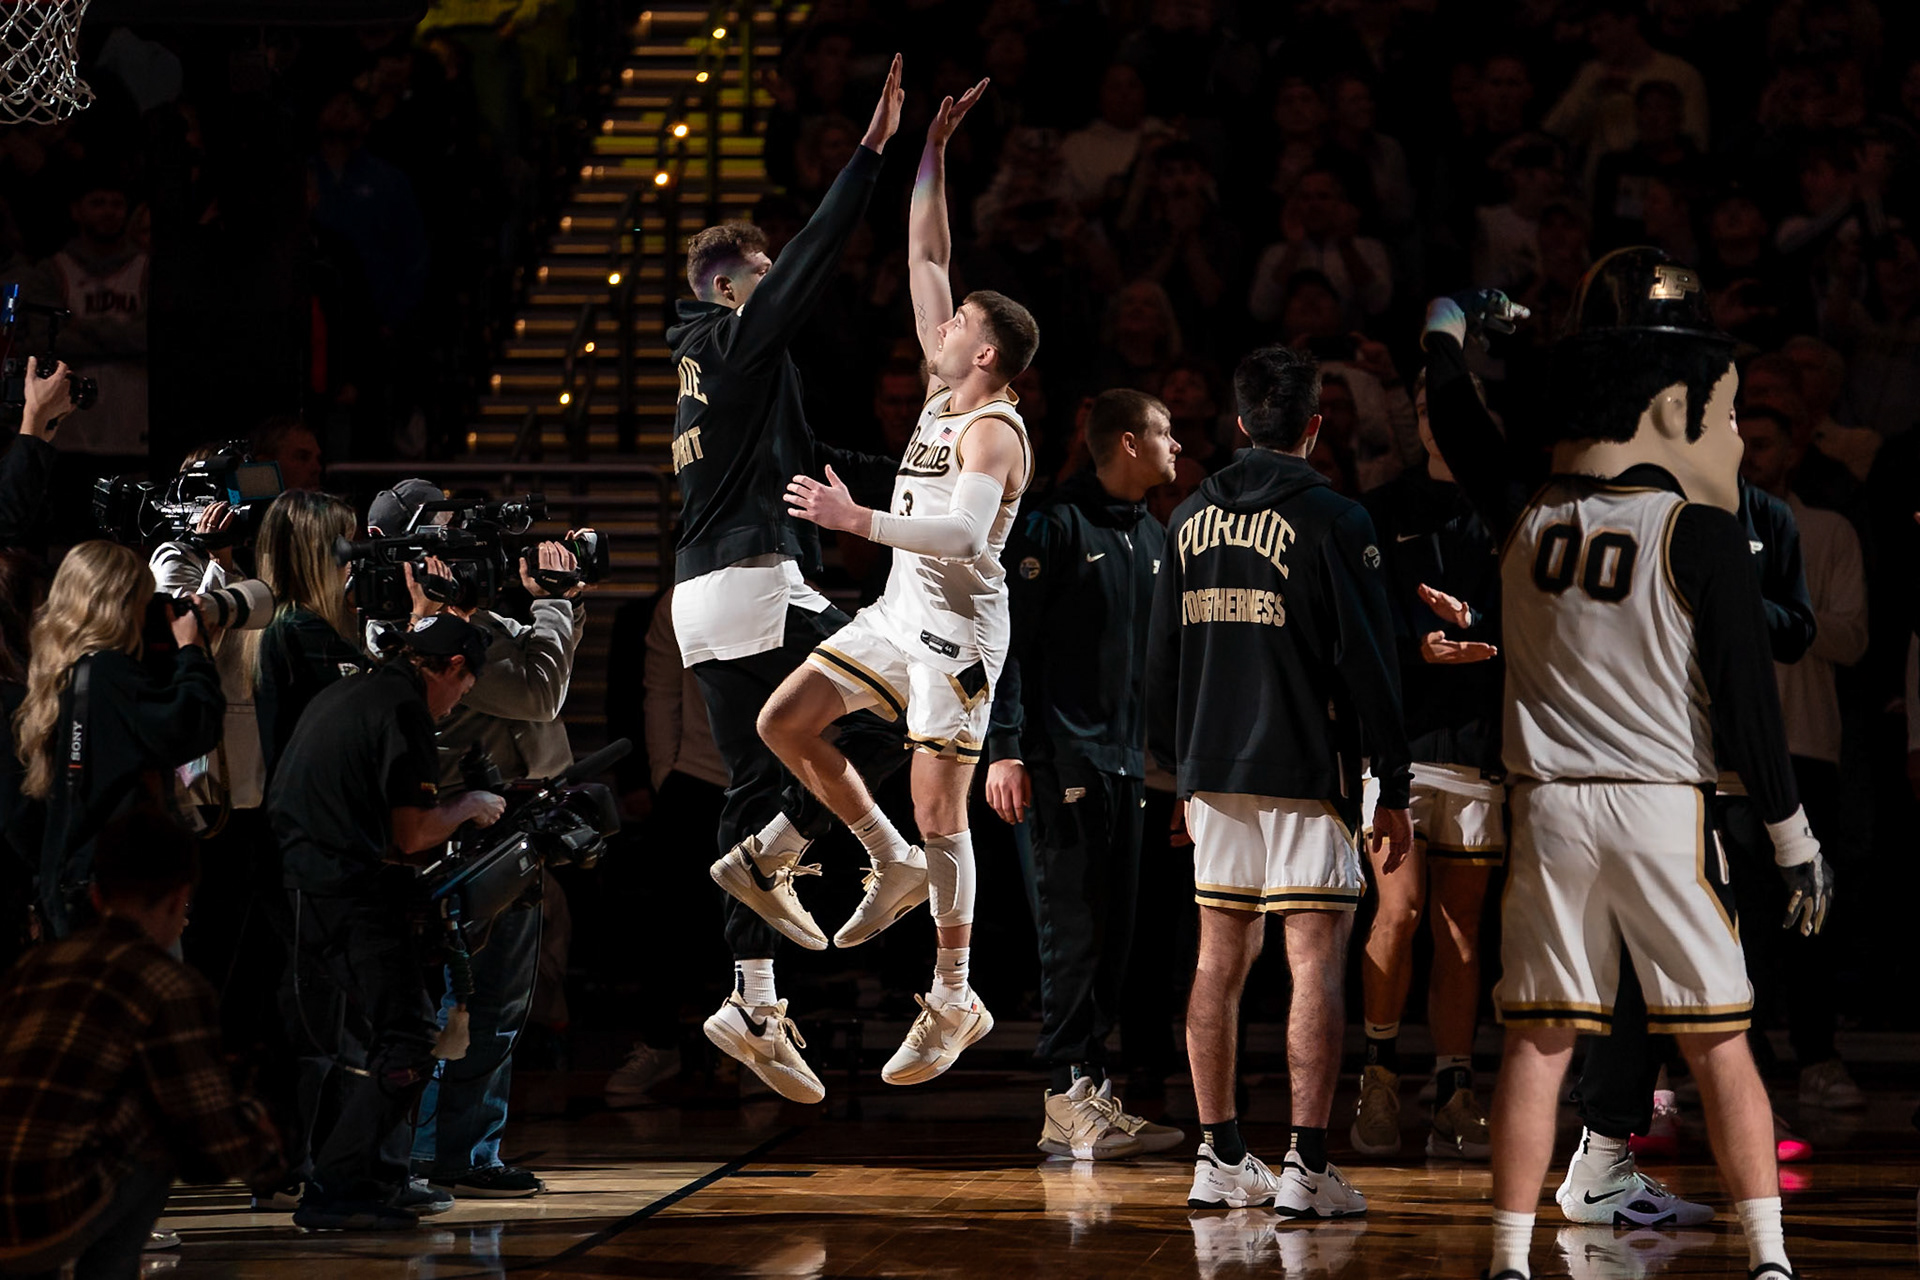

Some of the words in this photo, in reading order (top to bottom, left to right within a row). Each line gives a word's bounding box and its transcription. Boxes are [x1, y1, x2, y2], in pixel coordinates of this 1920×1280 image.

[1178, 504, 1296, 580] PURDUE
[1531, 520, 1639, 604] 00
[70, 720, 83, 761] SONY
